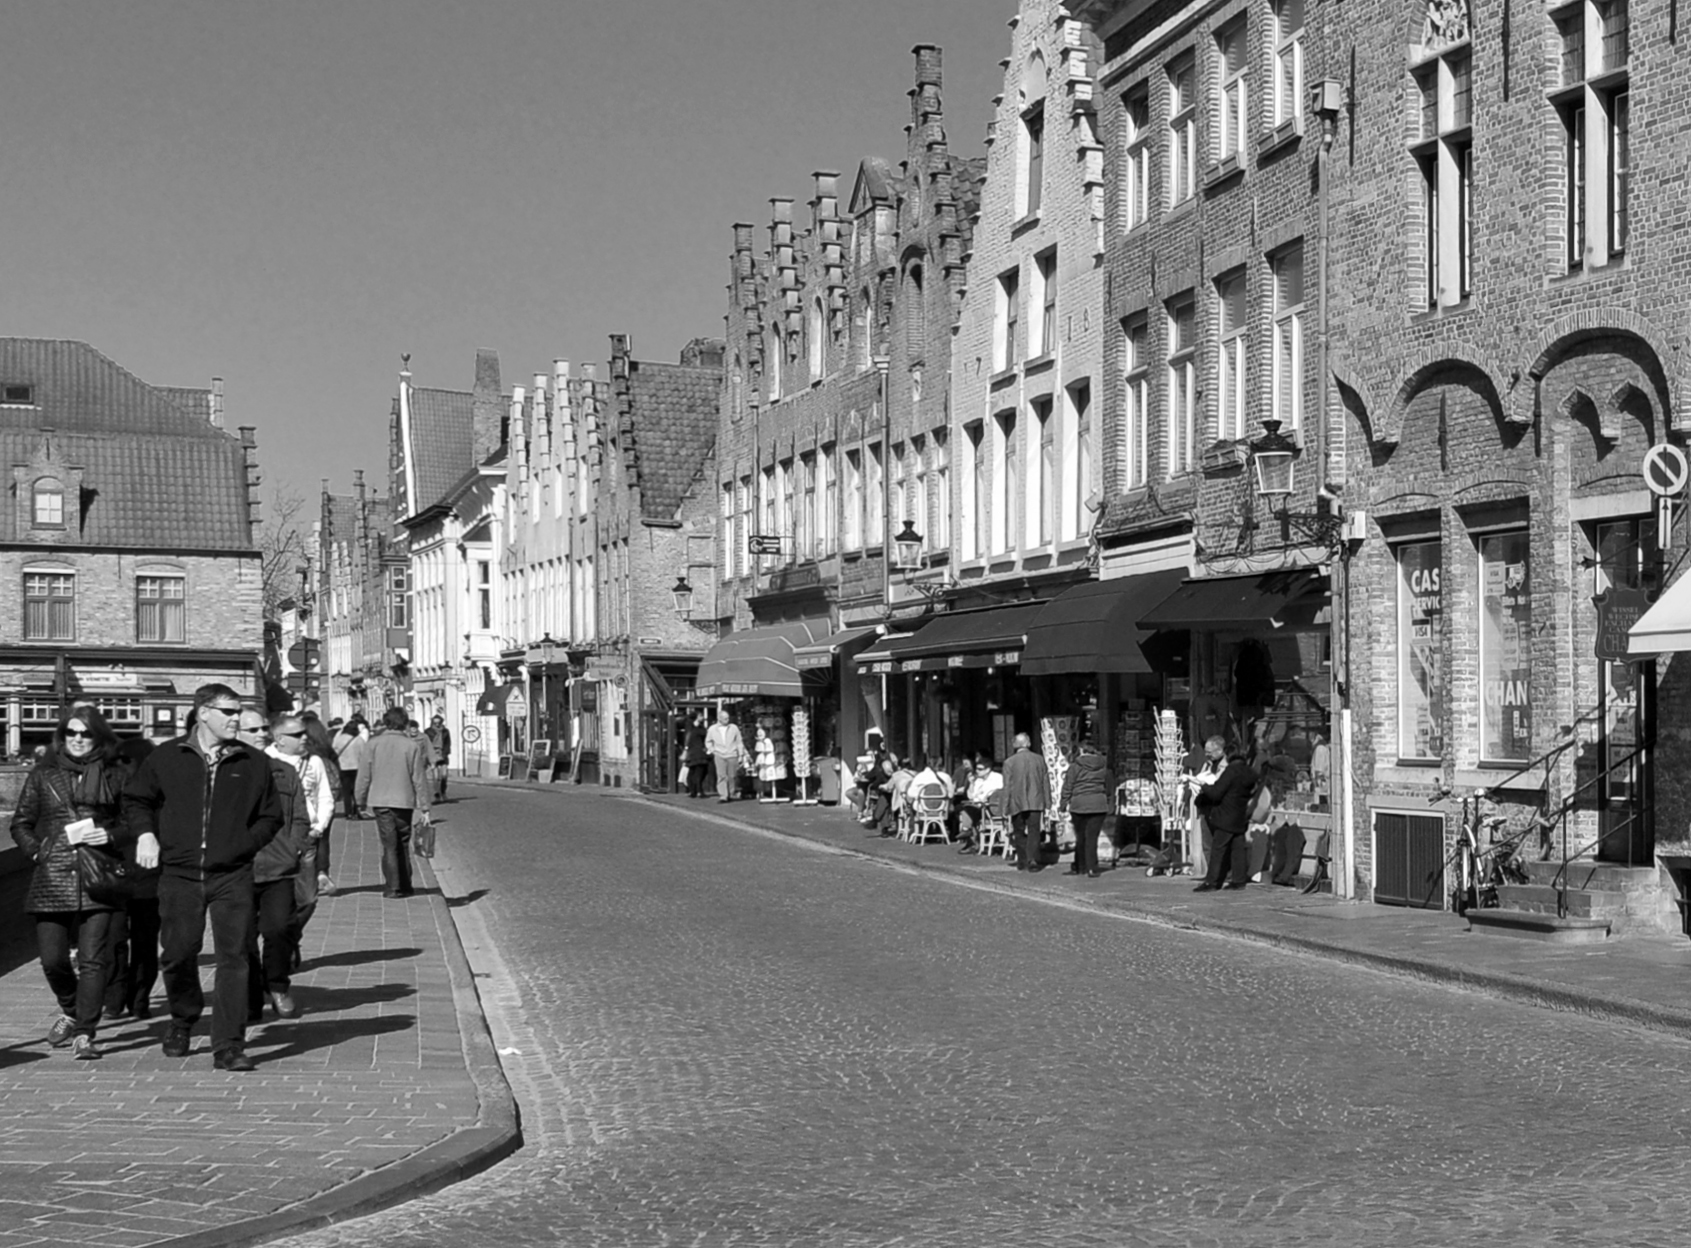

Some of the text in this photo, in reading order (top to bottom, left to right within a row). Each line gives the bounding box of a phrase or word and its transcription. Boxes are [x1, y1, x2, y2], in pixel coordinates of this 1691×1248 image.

[1411, 567, 1440, 593] CAS
[1603, 634, 1628, 652] CHA
[1485, 680, 1528, 706] CHAN
